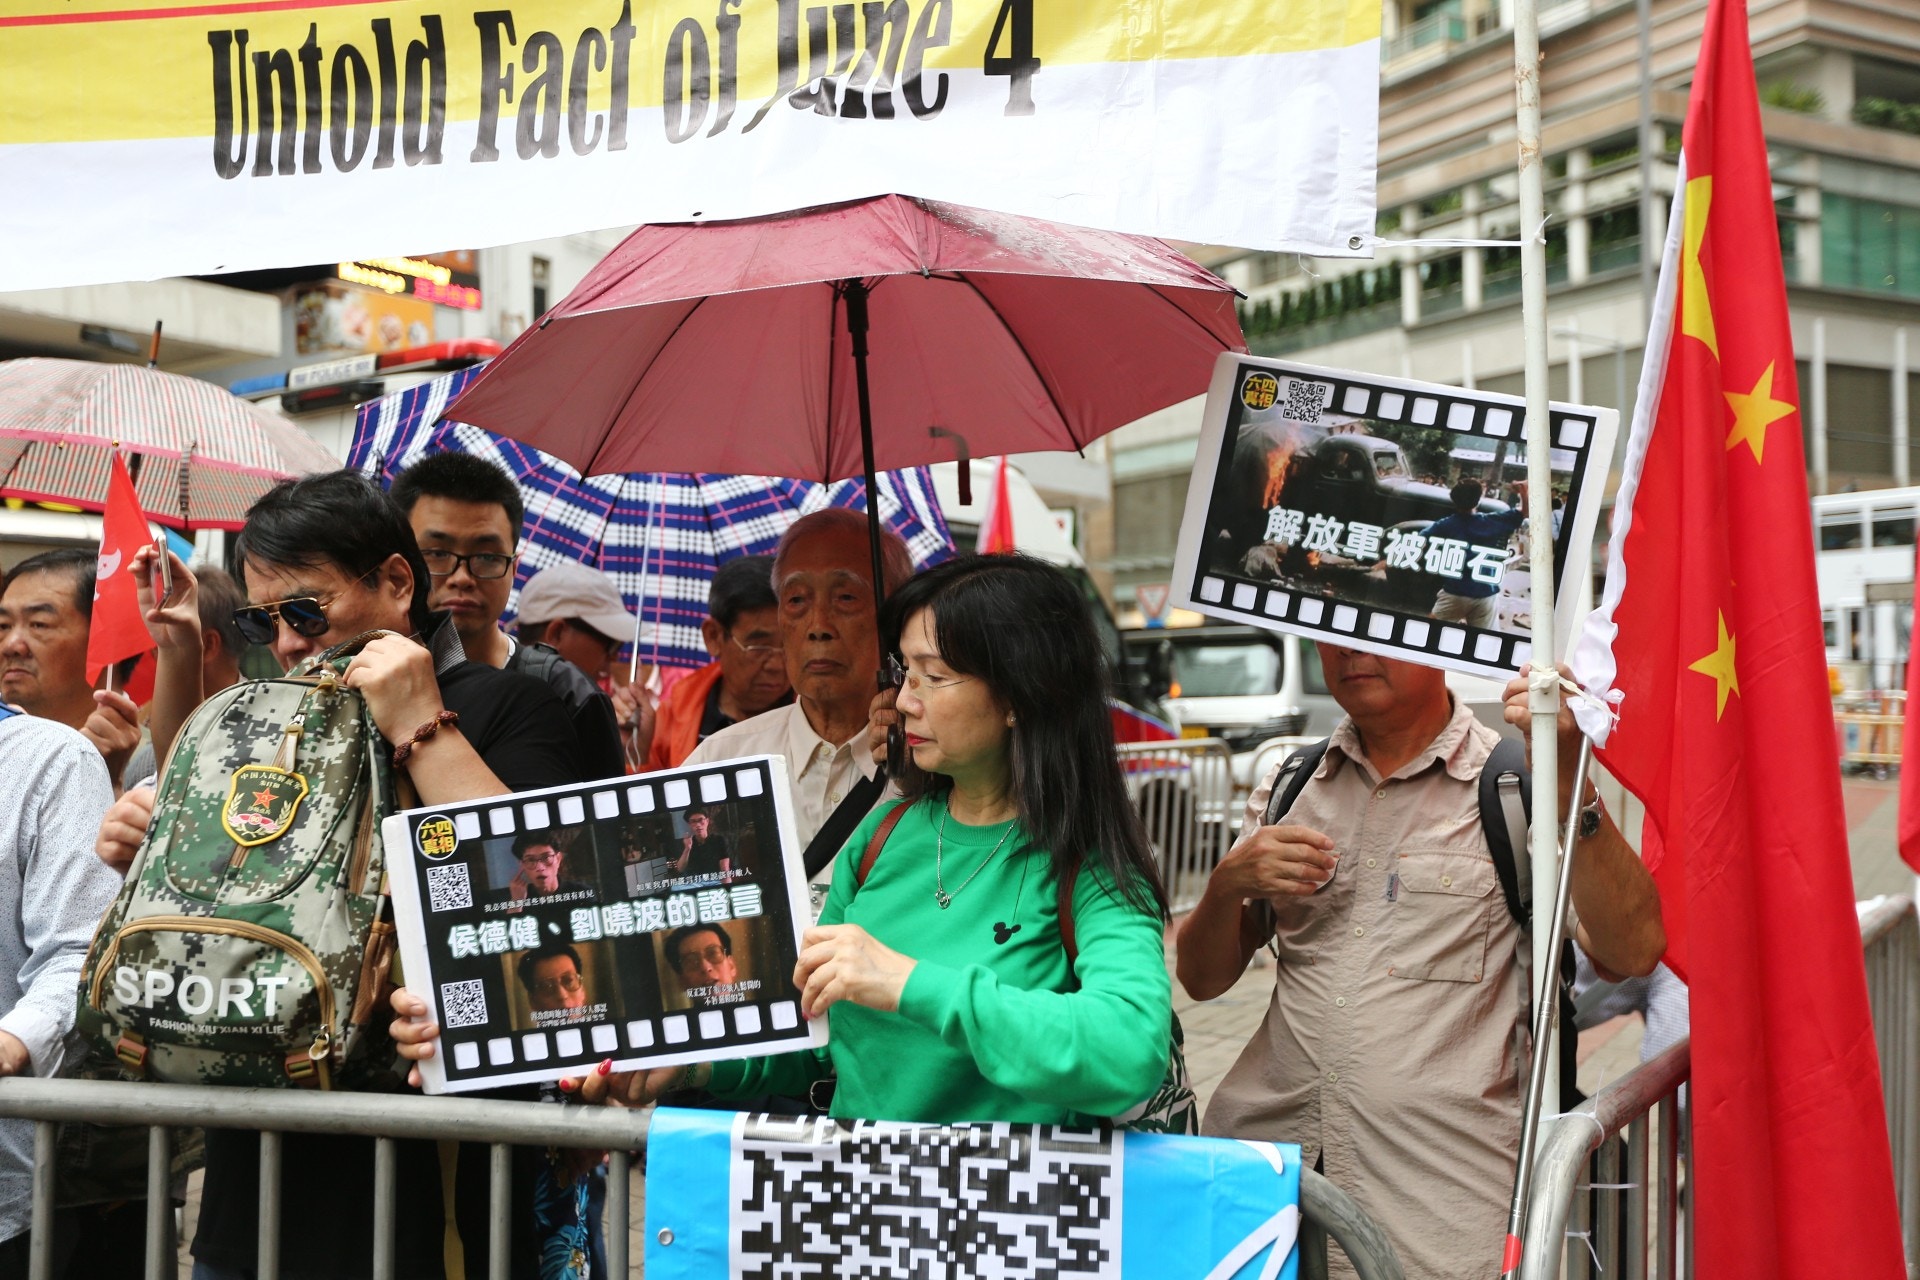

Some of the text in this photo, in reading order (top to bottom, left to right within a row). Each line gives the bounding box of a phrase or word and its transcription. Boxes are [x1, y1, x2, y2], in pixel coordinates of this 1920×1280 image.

[208, 0, 1042, 180] Untold Fact of June 4
[1246, 376, 1277, 393] 六四
[1263, 505, 1510, 586] 解放軍被砸石
[240, 772, 302, 789] 中国人民解放军
[420, 819, 454, 839] 六四
[448, 885, 763, 960] 侯德健、劉曉波的證言
[114, 966, 289, 1017] SPORT
[149, 1017, 195, 1034] FASHION
[199, 1024, 216, 1034] XIU
[265, 1024, 285, 1035] LIE
